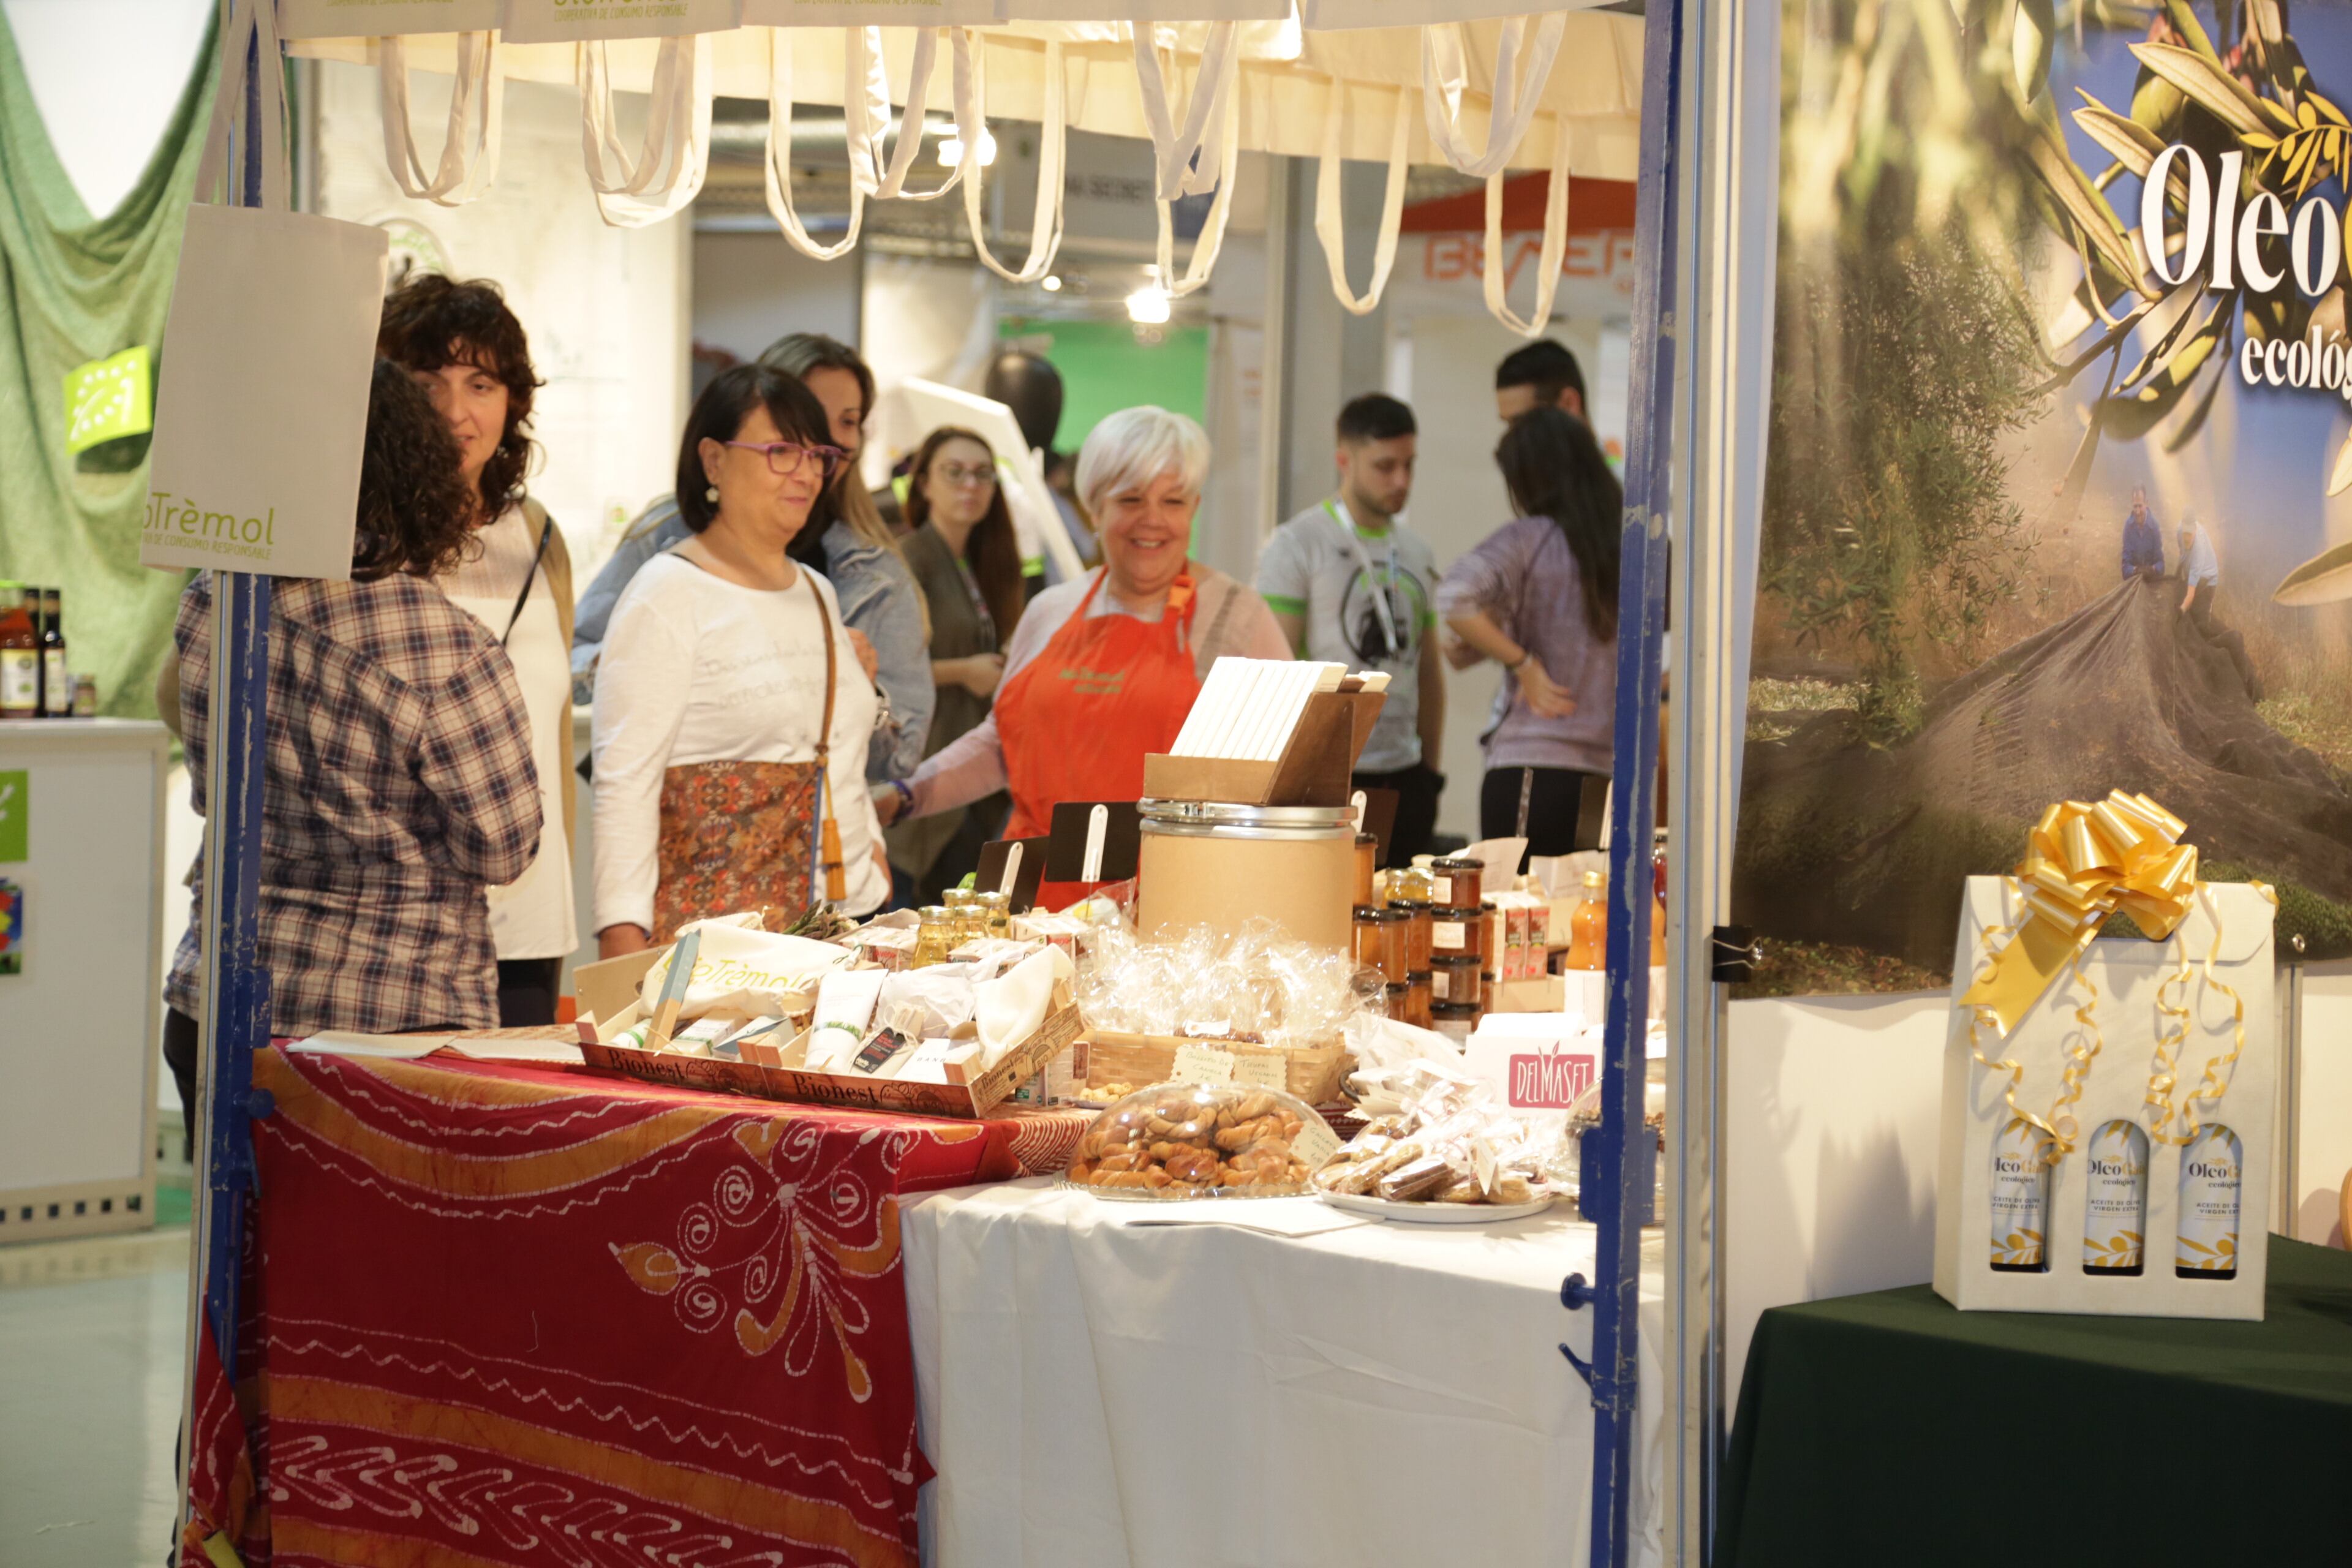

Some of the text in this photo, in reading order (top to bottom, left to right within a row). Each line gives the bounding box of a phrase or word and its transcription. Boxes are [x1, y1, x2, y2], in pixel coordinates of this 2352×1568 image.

[2142, 144, 2352, 297] Oleo
[164, 535, 209, 551] CONSUMO
[211, 540, 272, 560] RESPONSABLE
[607, 1049, 686, 1083] Bionest
[981, 1058, 1016, 1090] Bionest
[1036, 1054, 1049, 1068] BIO
[791, 1073, 879, 1104] Bionest
[1516, 1055, 1590, 1104] DELMASET
